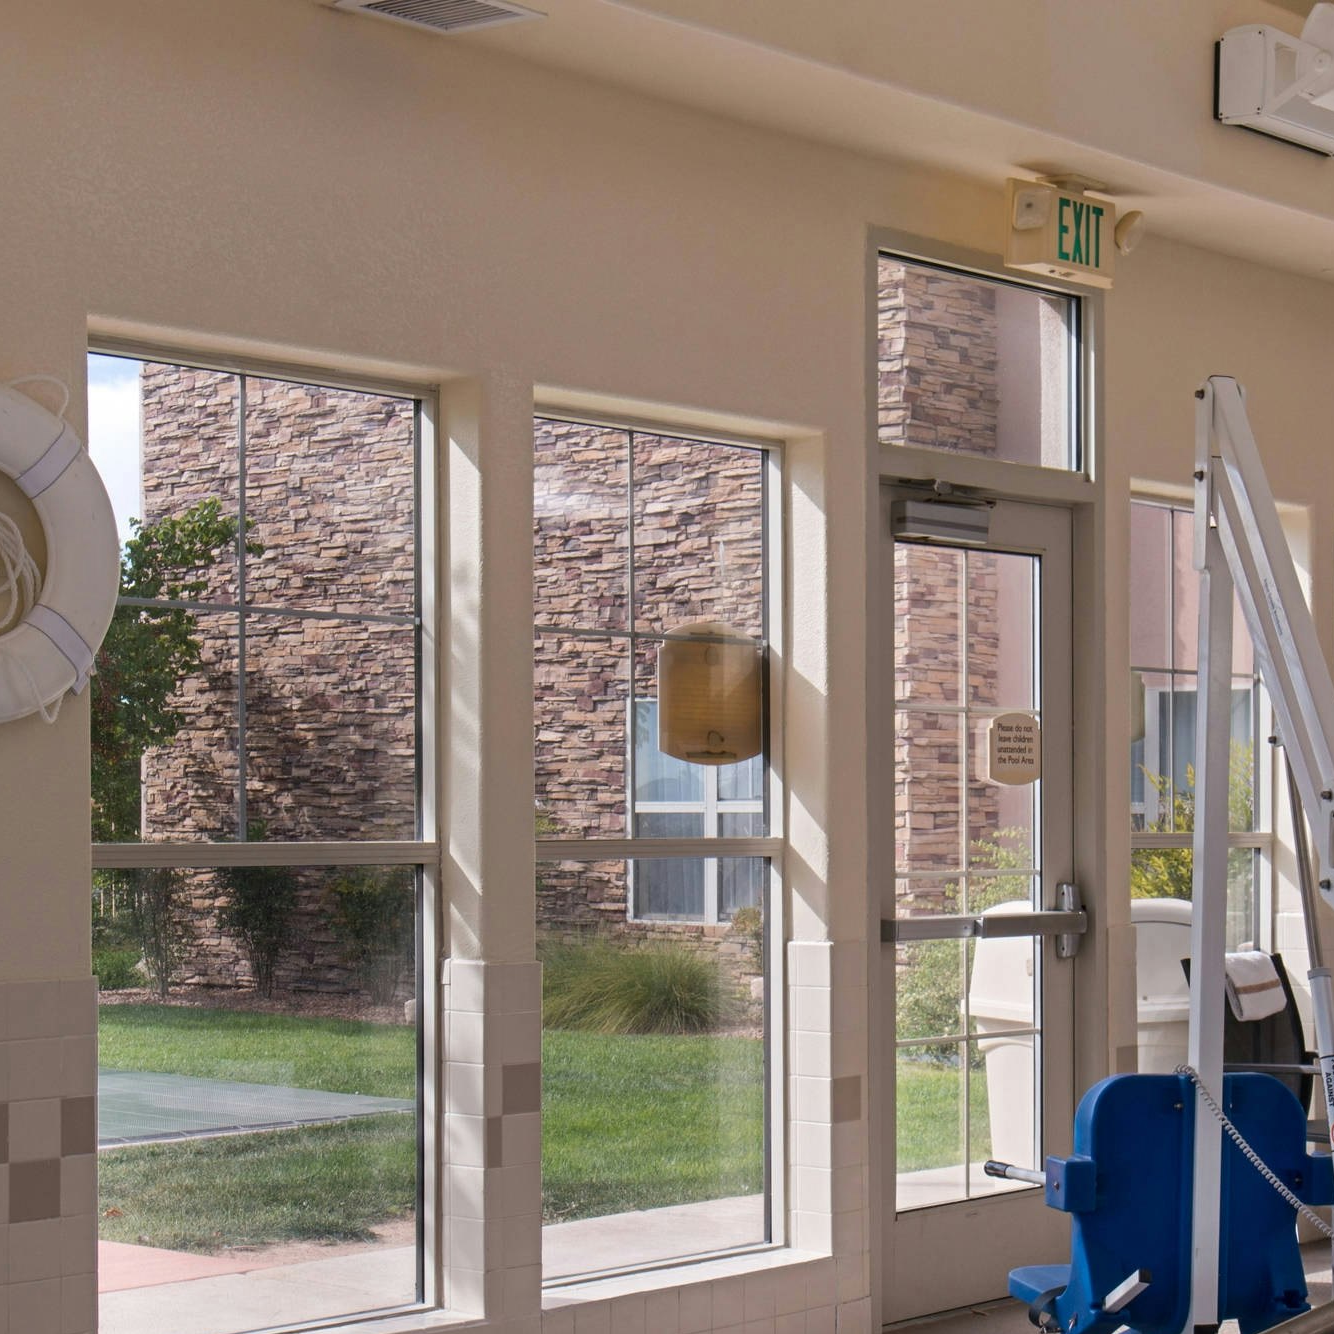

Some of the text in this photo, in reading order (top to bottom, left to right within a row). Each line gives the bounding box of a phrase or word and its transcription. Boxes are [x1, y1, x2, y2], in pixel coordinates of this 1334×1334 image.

[1058, 196, 1104, 269] EXIT
[997, 722, 1034, 733] Please do not
[998, 733, 1034, 744] leave children
[997, 745, 1027, 754] unattended
[997, 755, 1035, 765] the Pool Area
[1325, 1071, 1334, 1107] AGAINST
